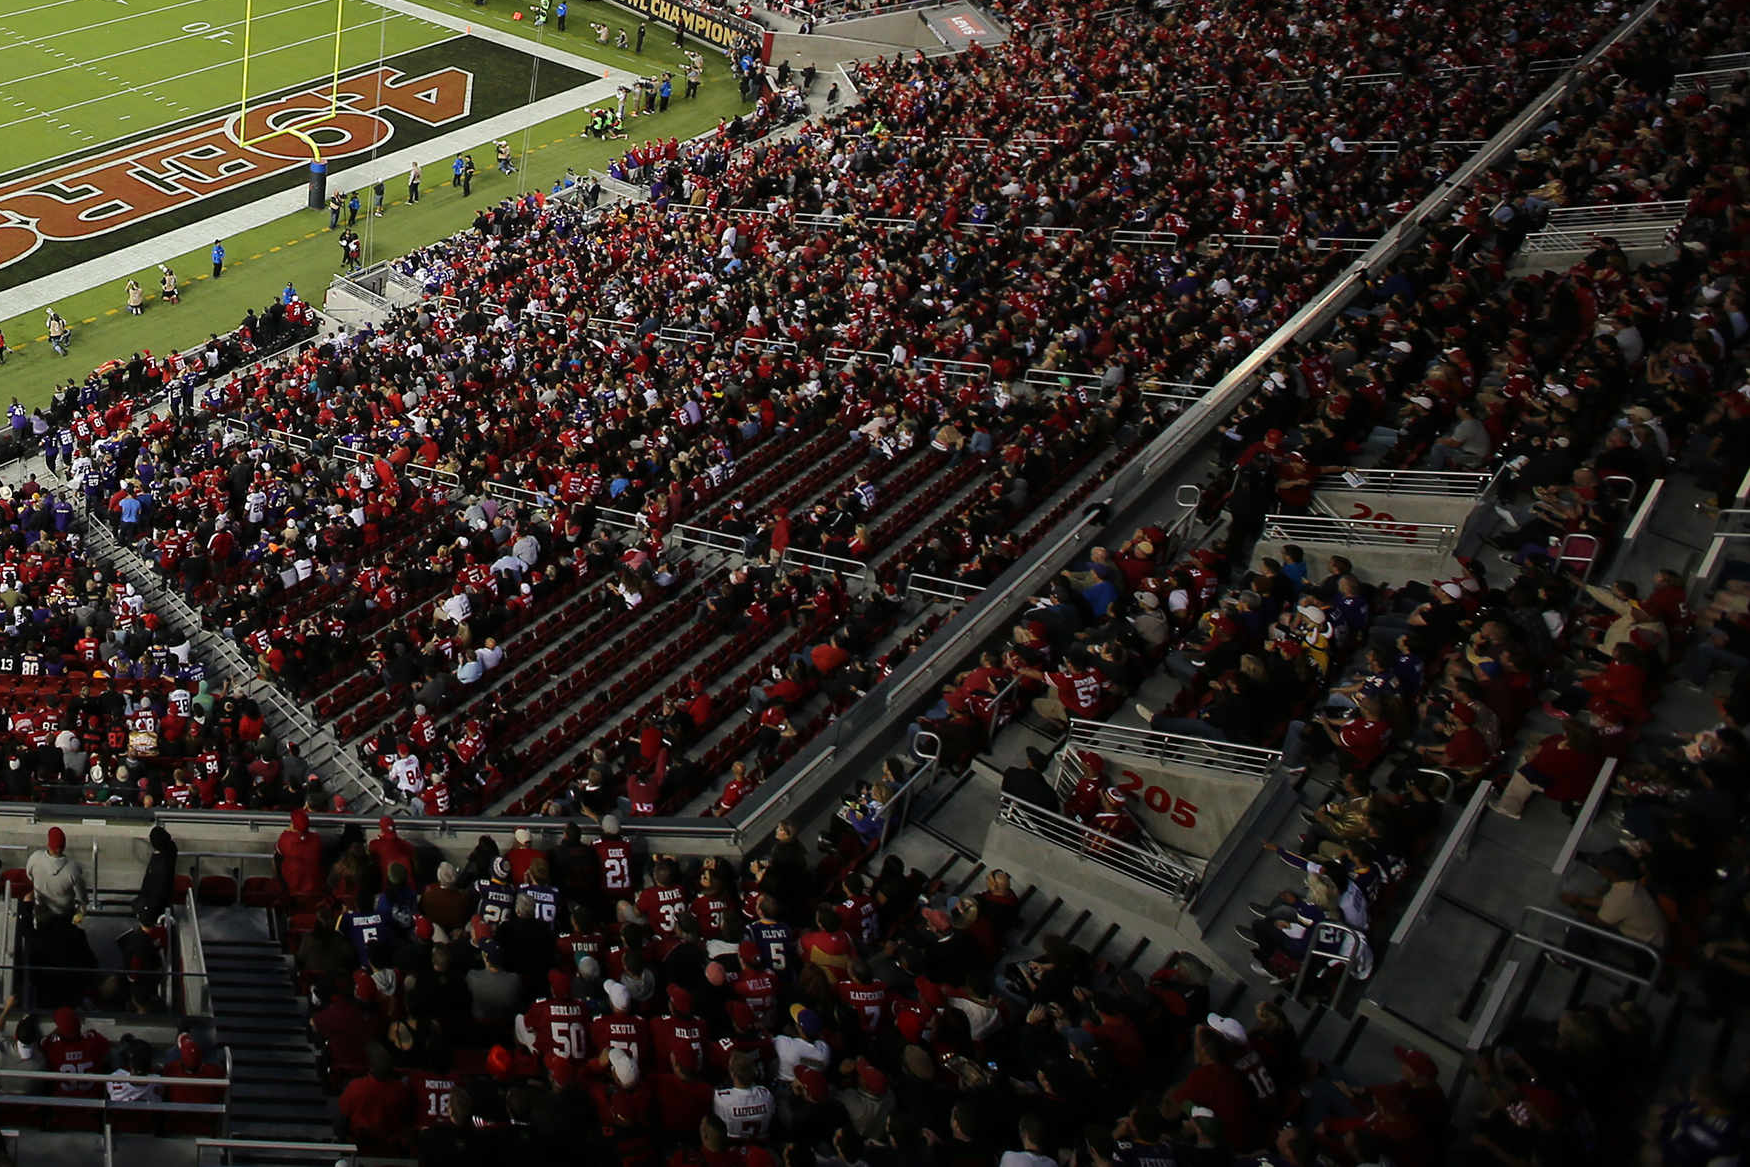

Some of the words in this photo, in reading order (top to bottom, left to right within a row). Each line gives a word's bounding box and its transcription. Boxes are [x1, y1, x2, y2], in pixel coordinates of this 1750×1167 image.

[180, 20, 234, 43] 10
[167, 548, 174, 558] 7
[390, 591, 397, 603] 8
[0, 658, 13, 671] 13
[22, 661, 39, 675] 80
[1076, 684, 1101, 708] 53
[107, 732, 124, 747] 87
[423, 728, 436, 742] 85
[206, 760, 218, 774] 94
[404, 768, 422, 786] 84
[1118, 770, 1199, 829] 205
[608, 849, 624, 857] GORE
[605, 858, 631, 888] 21
[488, 891, 512, 902] PETERS
[658, 888, 682, 902] HAYNE
[362, 927, 378, 943] 5
[761, 929, 787, 940] KLUWE
[571, 942, 599, 953] YOUNG
[770, 943, 786, 971] 5
[746, 978, 772, 990] WILLIS
[550, 1005, 581, 1016] BORLAND
[865, 1006, 881, 1031] 7
[610, 1024, 636, 1035] SKUTA
[675, 1027, 700, 1038] MILLER
[551, 1022, 586, 1060] 50
[425, 1079, 455, 1089] MONTANA
[1248, 1066, 1276, 1099] 16
